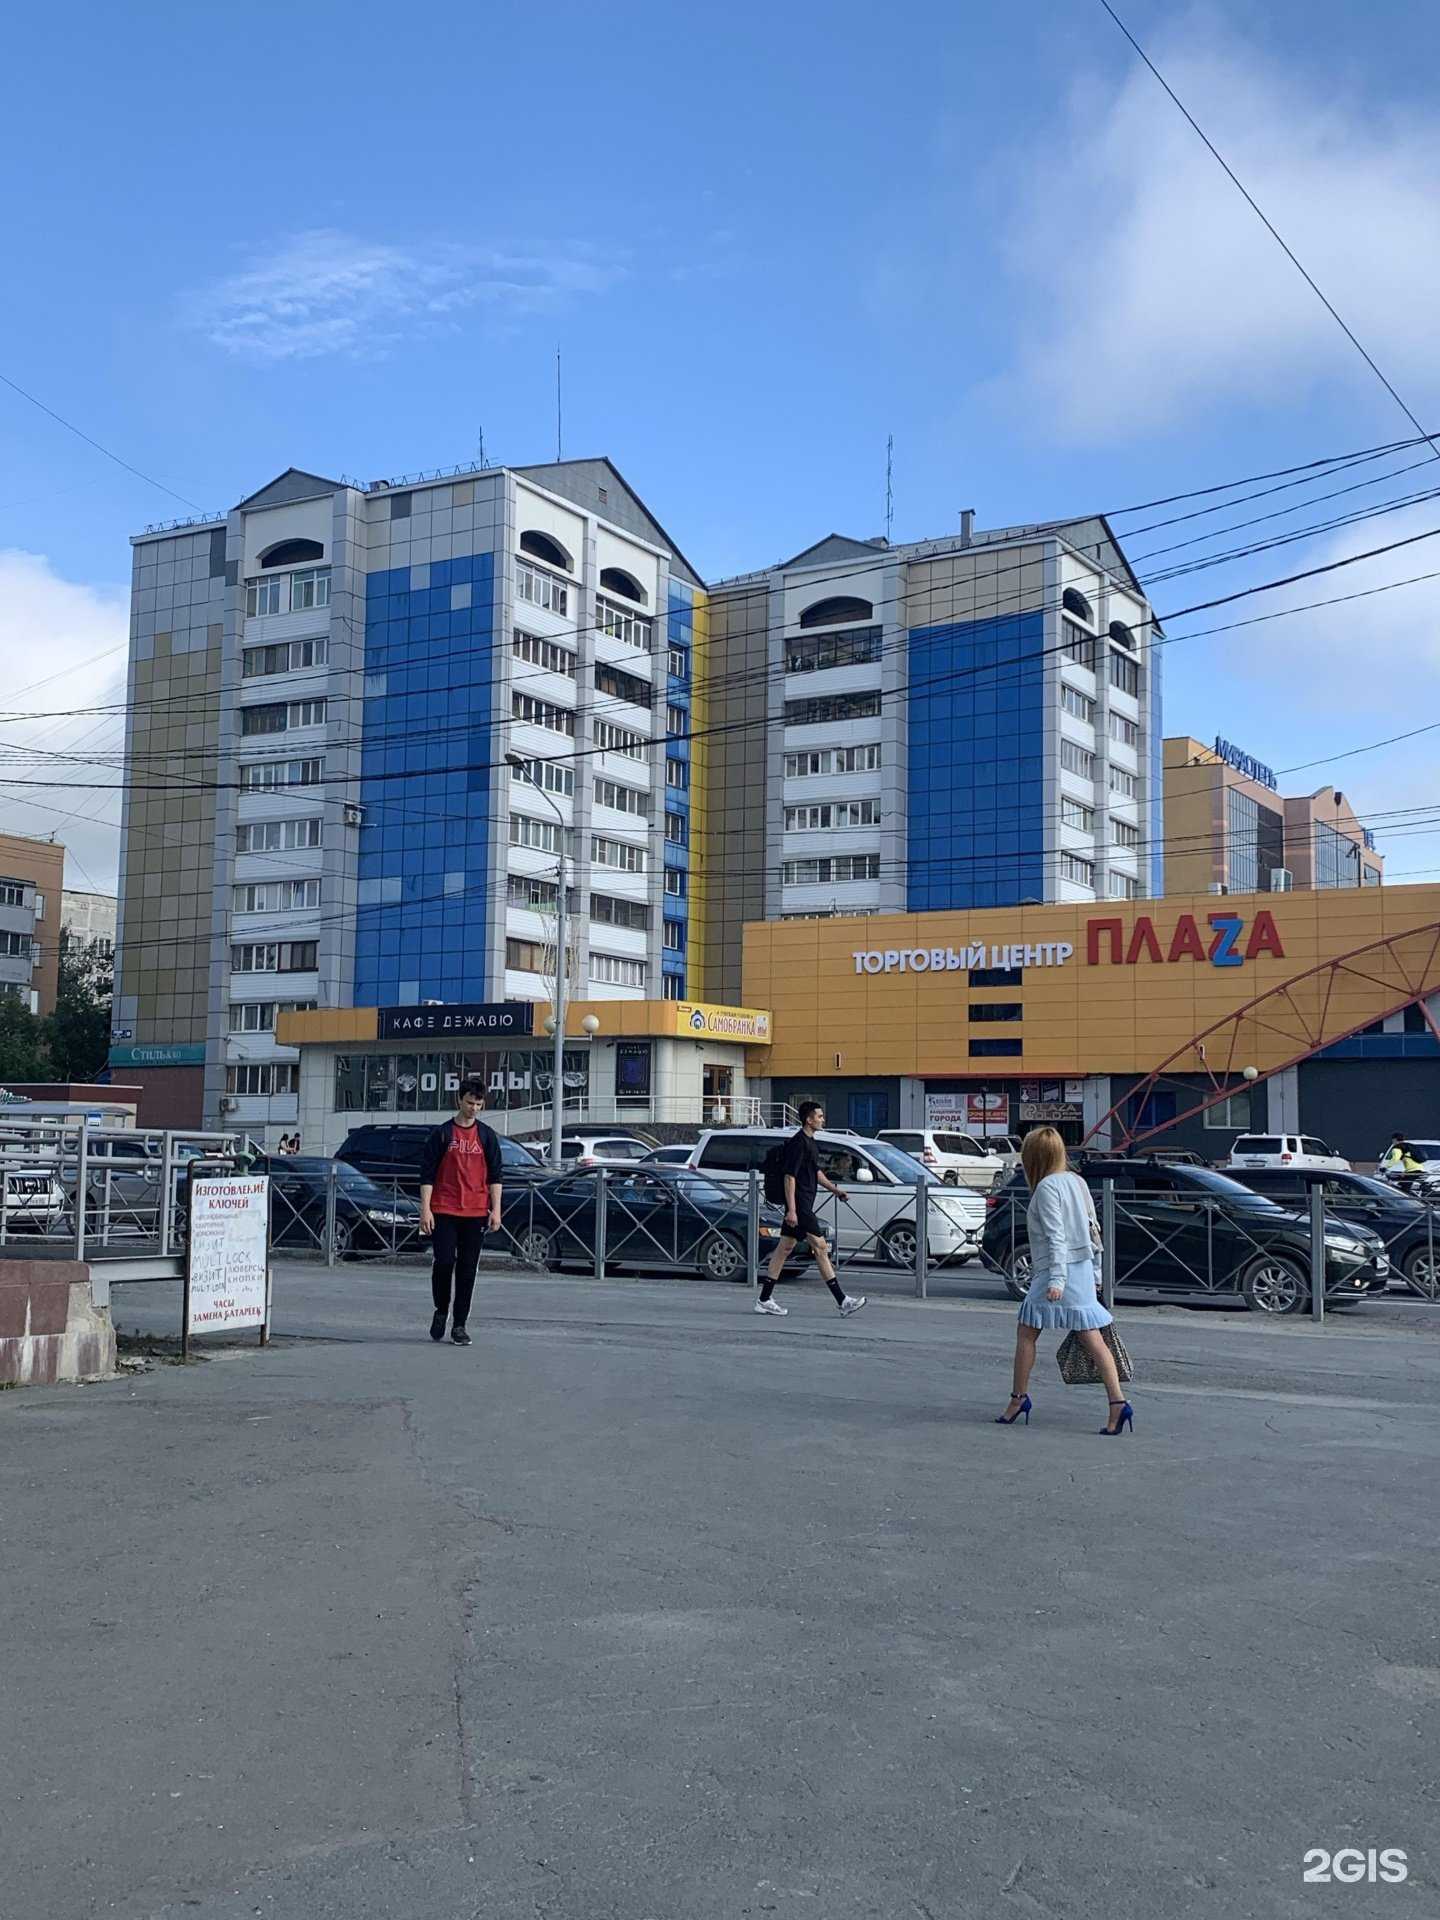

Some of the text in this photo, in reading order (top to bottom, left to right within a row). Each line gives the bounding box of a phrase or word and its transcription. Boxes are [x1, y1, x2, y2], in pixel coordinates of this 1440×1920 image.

[853, 942, 1073, 974] ТОРГОВЫЙ ЦЕНТР
[394, 1014, 513, 1029] КАФЕ ДЕЖАВЮ
[421, 1071, 531, 1093] ОБДЫ
[930, 1114, 961, 1122] ГОРОДА
[448, 1140, 482, 1153] FILA
[195, 1184, 265, 1196] ИЗГОТОВЛЕНИЕ
[208, 1197, 249, 1209] КЛЮЧЕЙ
[213, 1299, 235, 1308] ЧАСЫ
[192, 1306, 262, 1322] ЗАМЕНА БАТАРЕЕК
